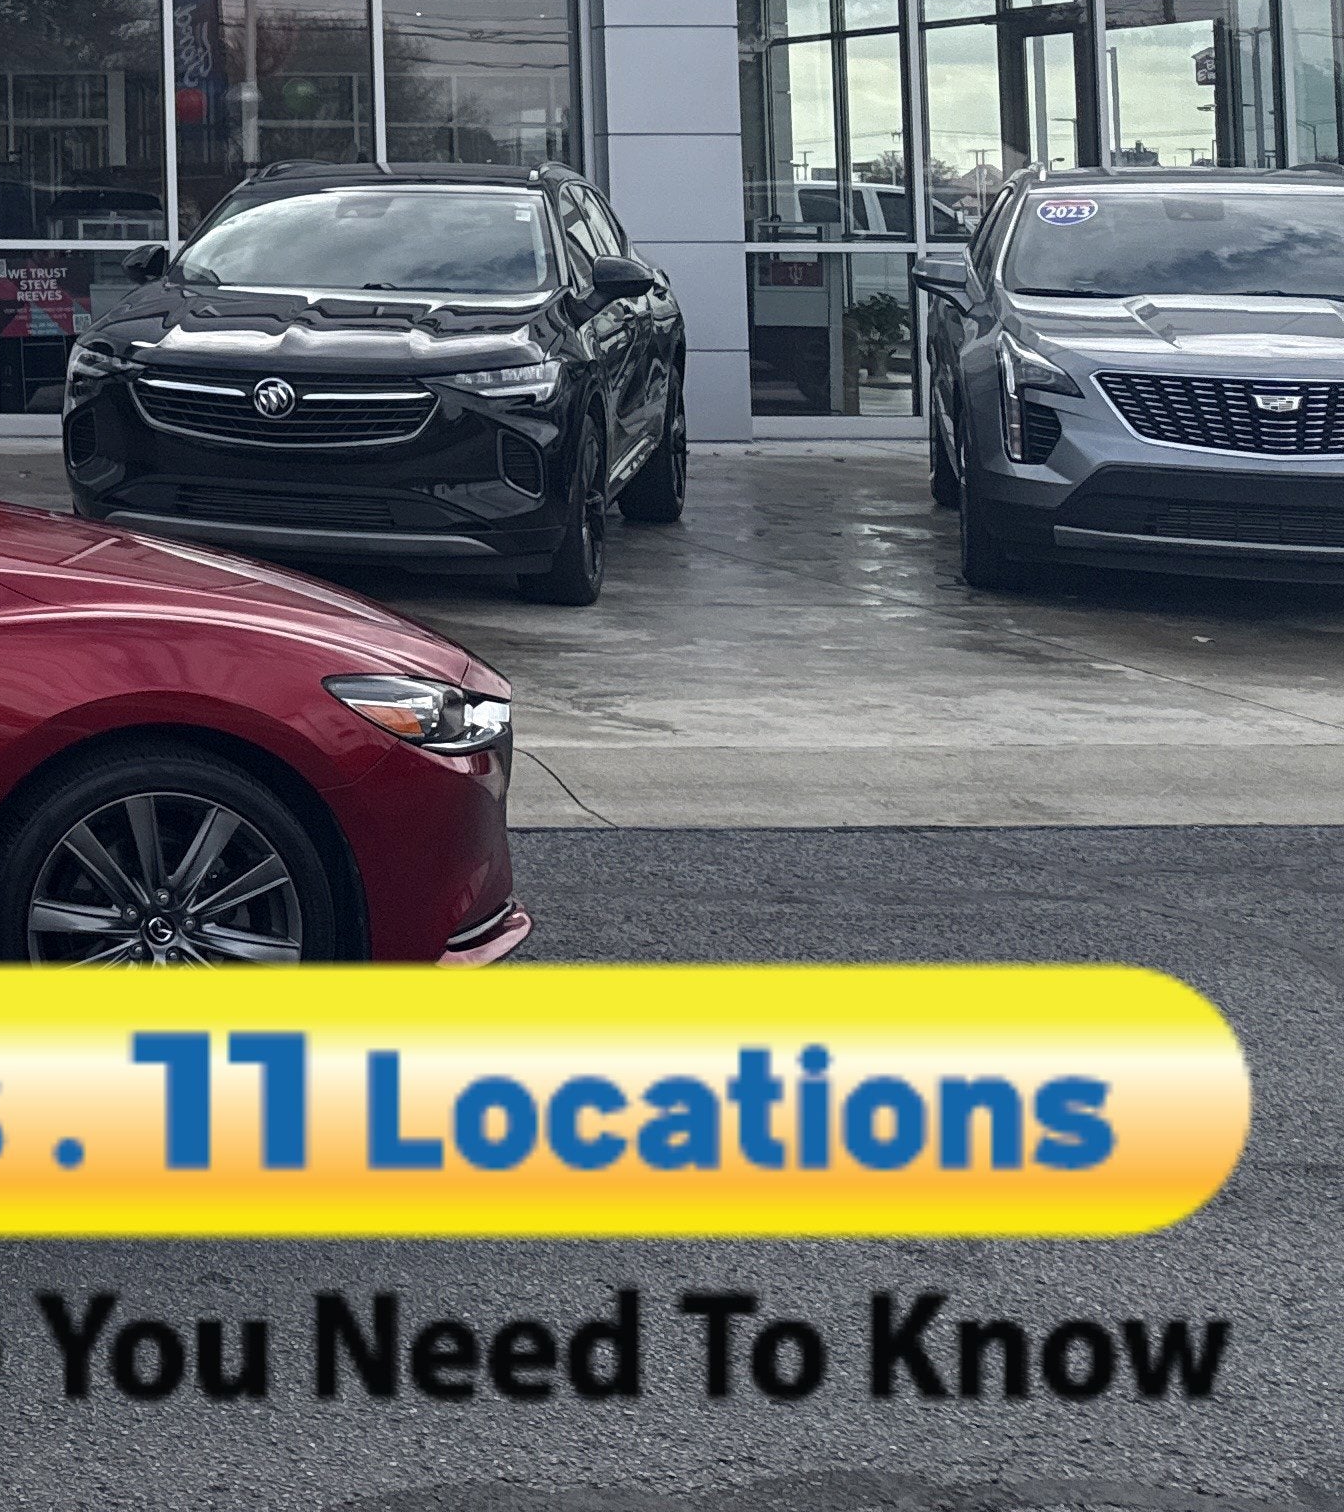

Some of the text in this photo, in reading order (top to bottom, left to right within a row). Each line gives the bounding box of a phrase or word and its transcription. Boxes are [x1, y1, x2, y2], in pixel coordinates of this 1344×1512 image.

[1045, 205, 1091, 219] 2023
[7, 267, 69, 279] WE TRUST
[19, 279, 58, 291] STEVE
[16, 290, 63, 302] REEVES
